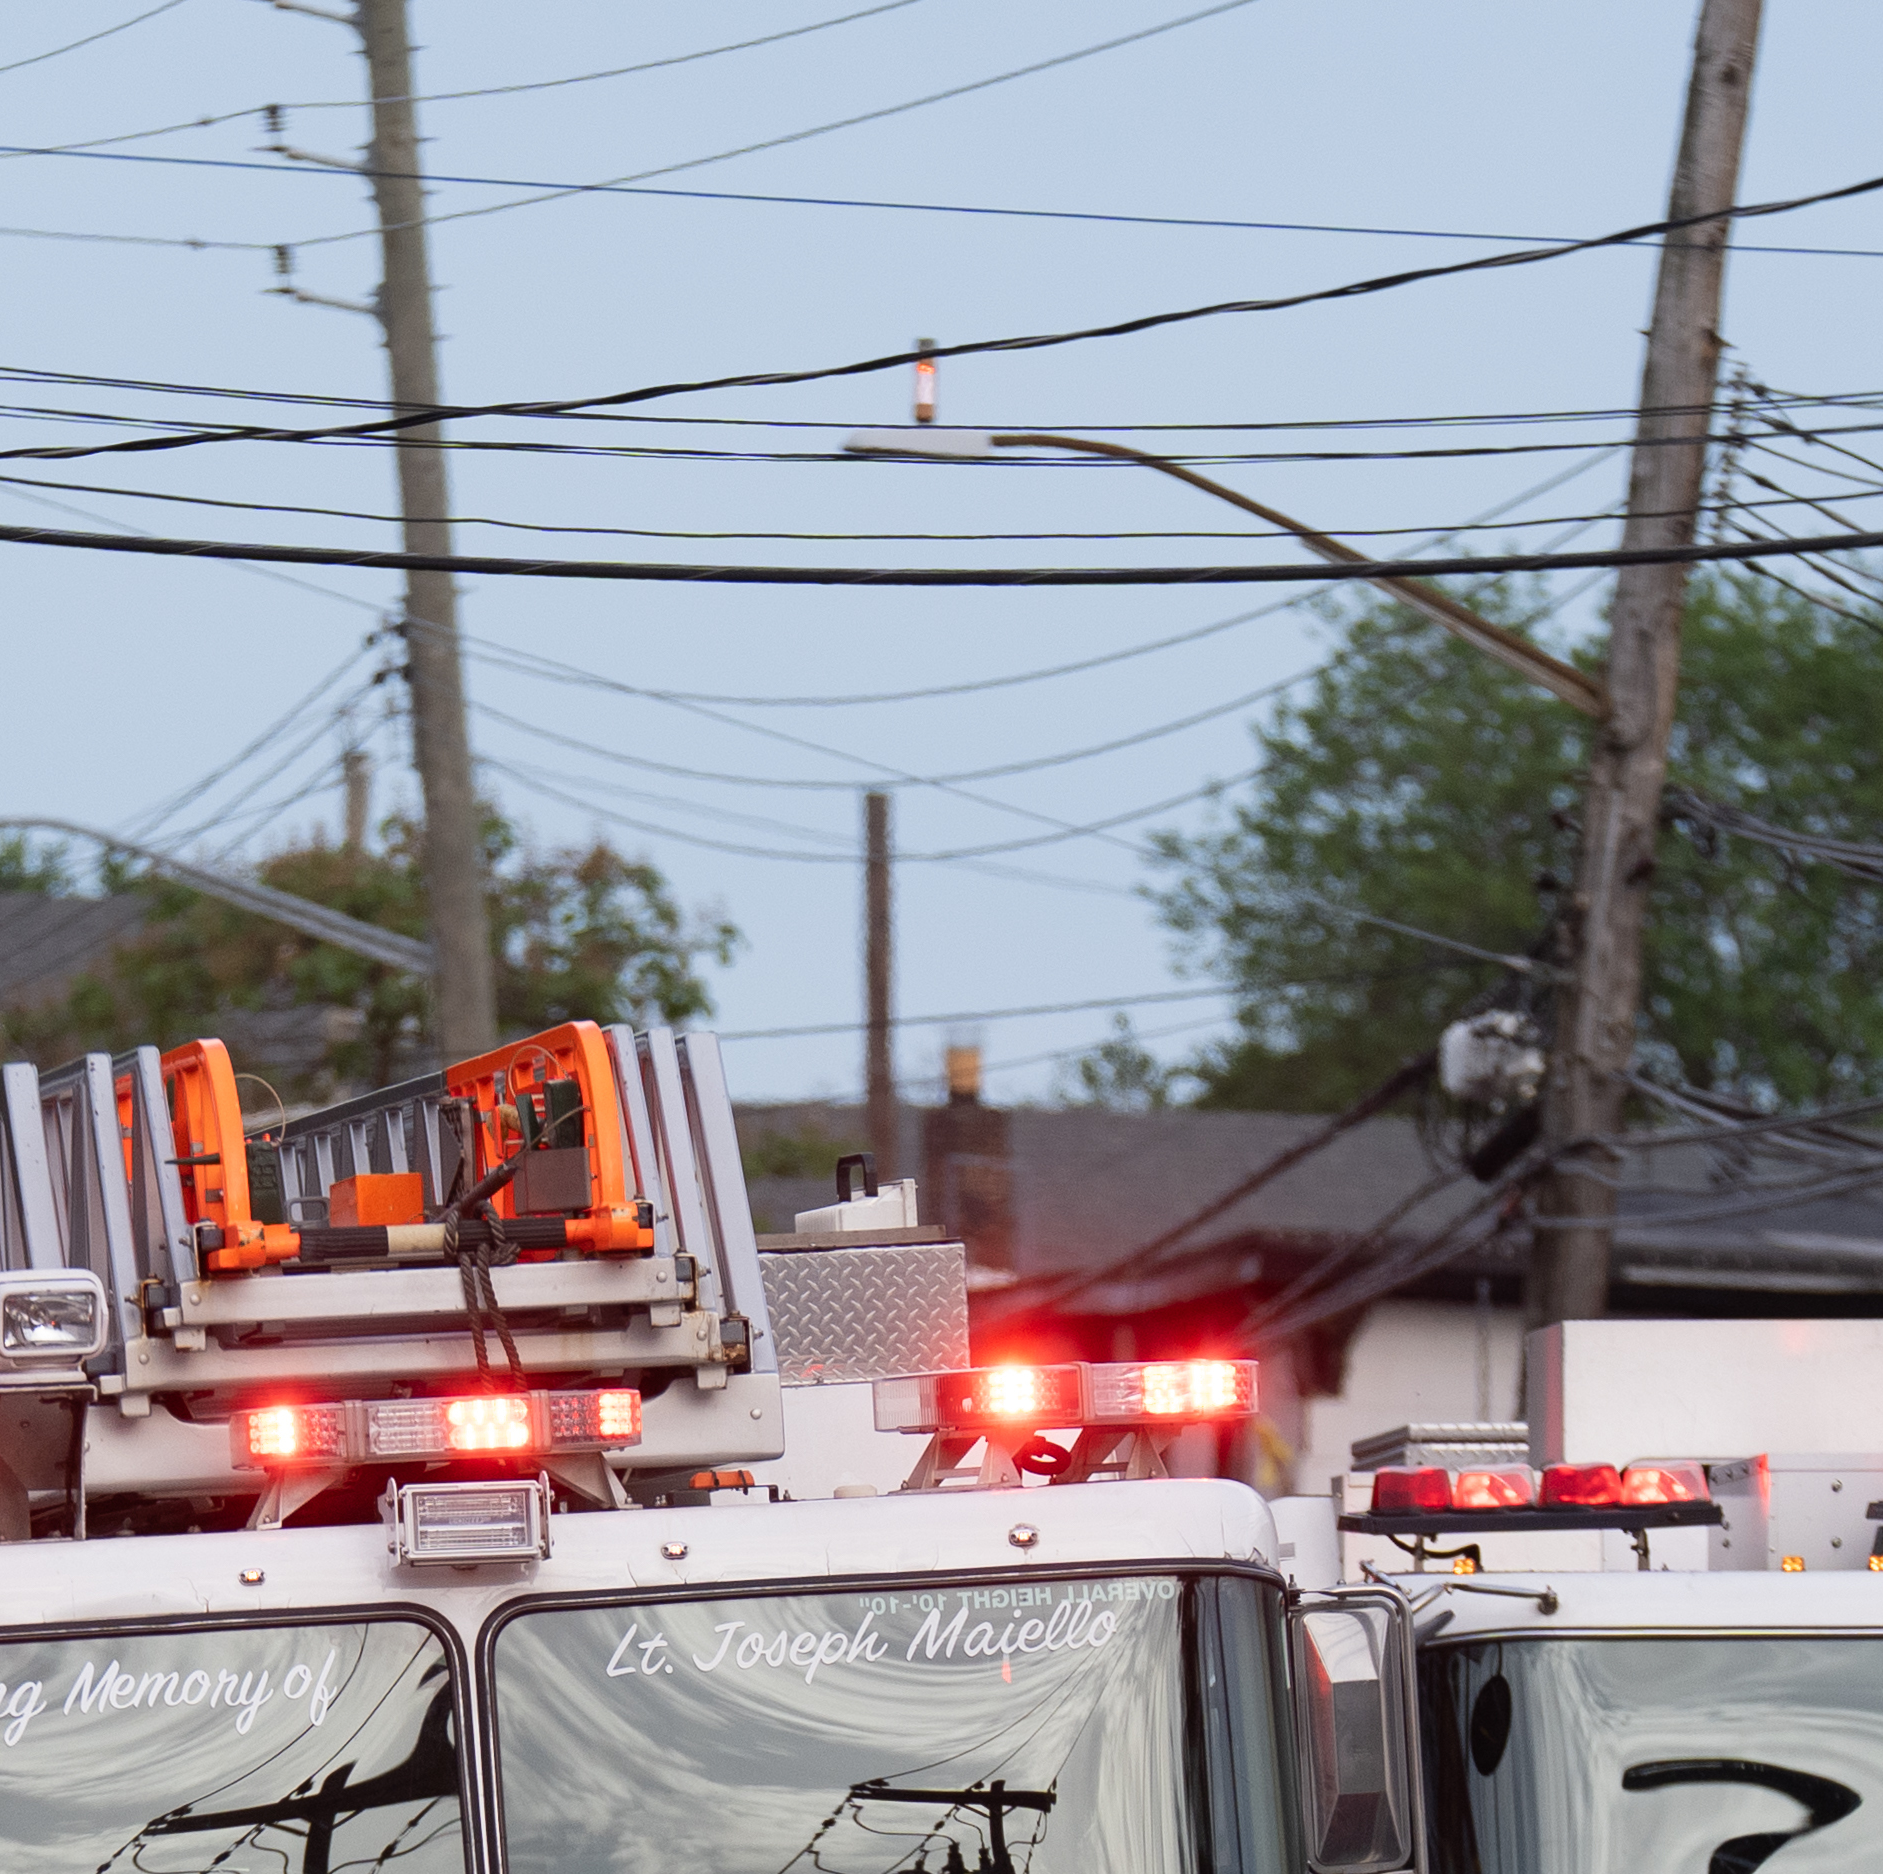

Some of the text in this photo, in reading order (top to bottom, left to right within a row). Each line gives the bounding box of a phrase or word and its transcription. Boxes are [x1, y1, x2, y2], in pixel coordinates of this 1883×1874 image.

[605, 1599, 1117, 1685] Lt. Joseph Maiello
[63, 1660, 274, 1735] Memory
[283, 1649, 338, 1728] of
